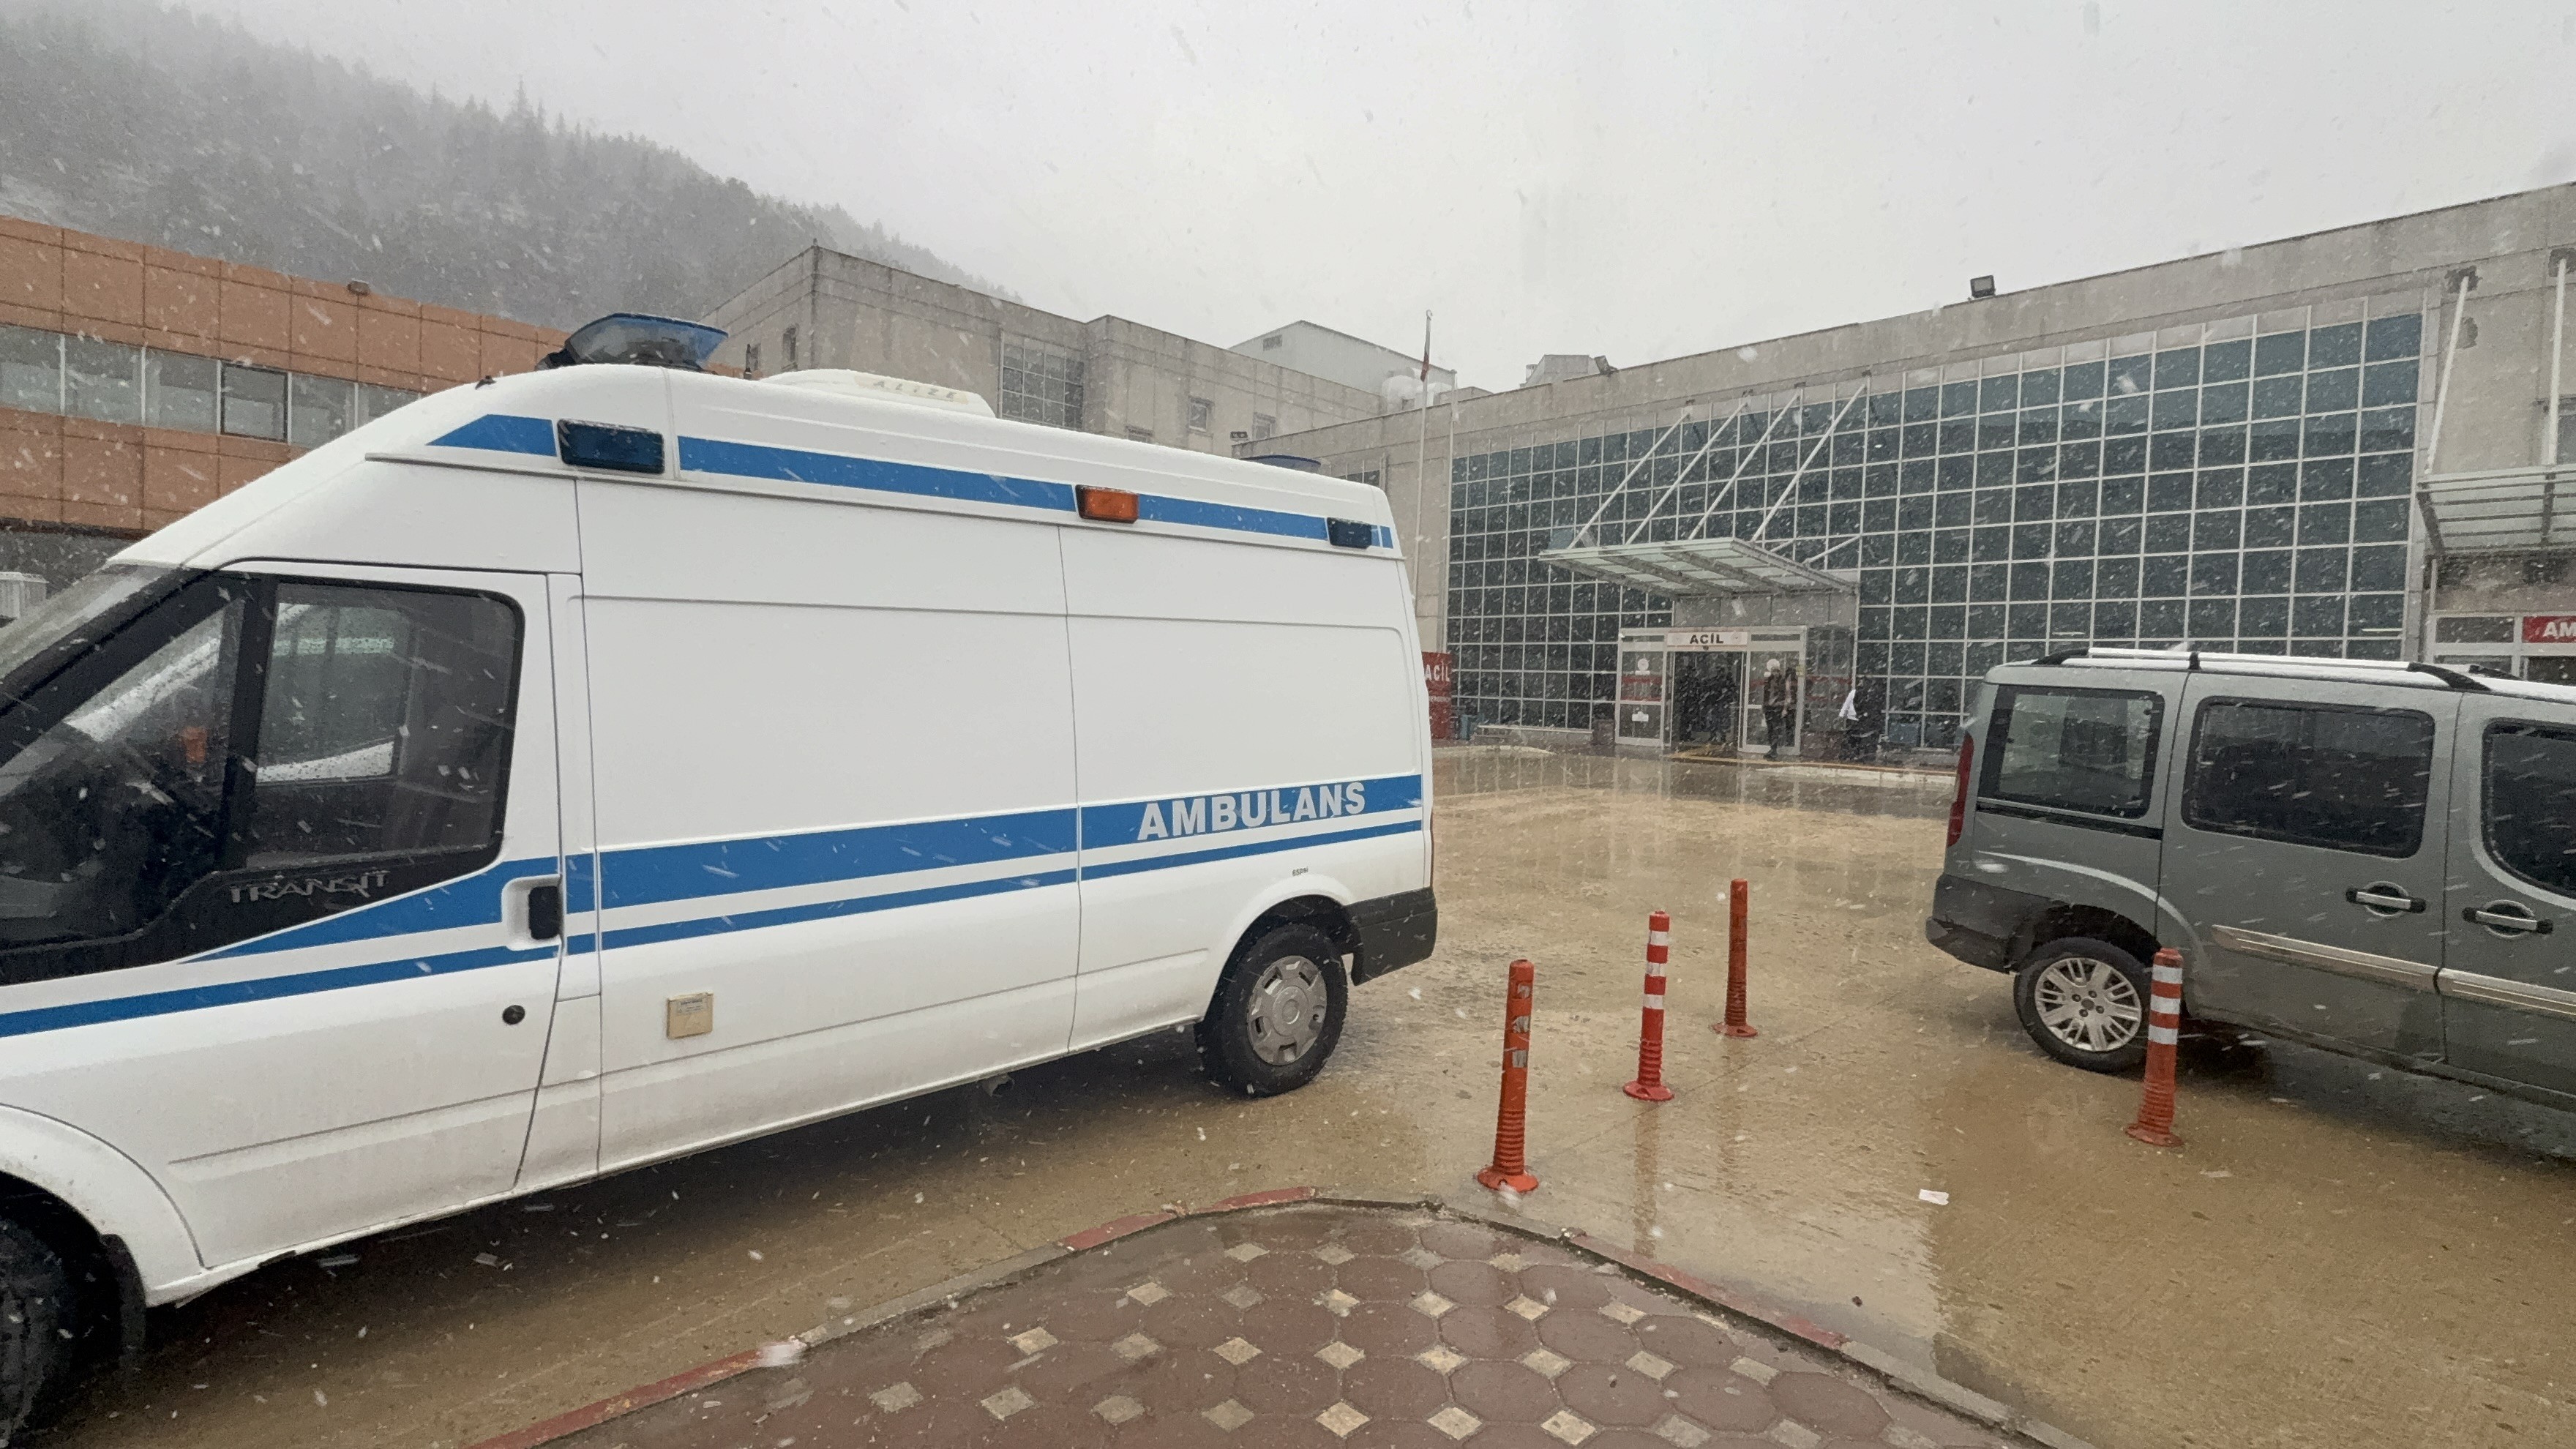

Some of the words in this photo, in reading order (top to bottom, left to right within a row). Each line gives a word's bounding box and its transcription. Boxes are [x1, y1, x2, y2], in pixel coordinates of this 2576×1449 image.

[1690, 633, 1723, 644] ACİL
[1137, 782, 1366, 841] AMBULANS
[230, 869, 390, 903] TRANSIT
